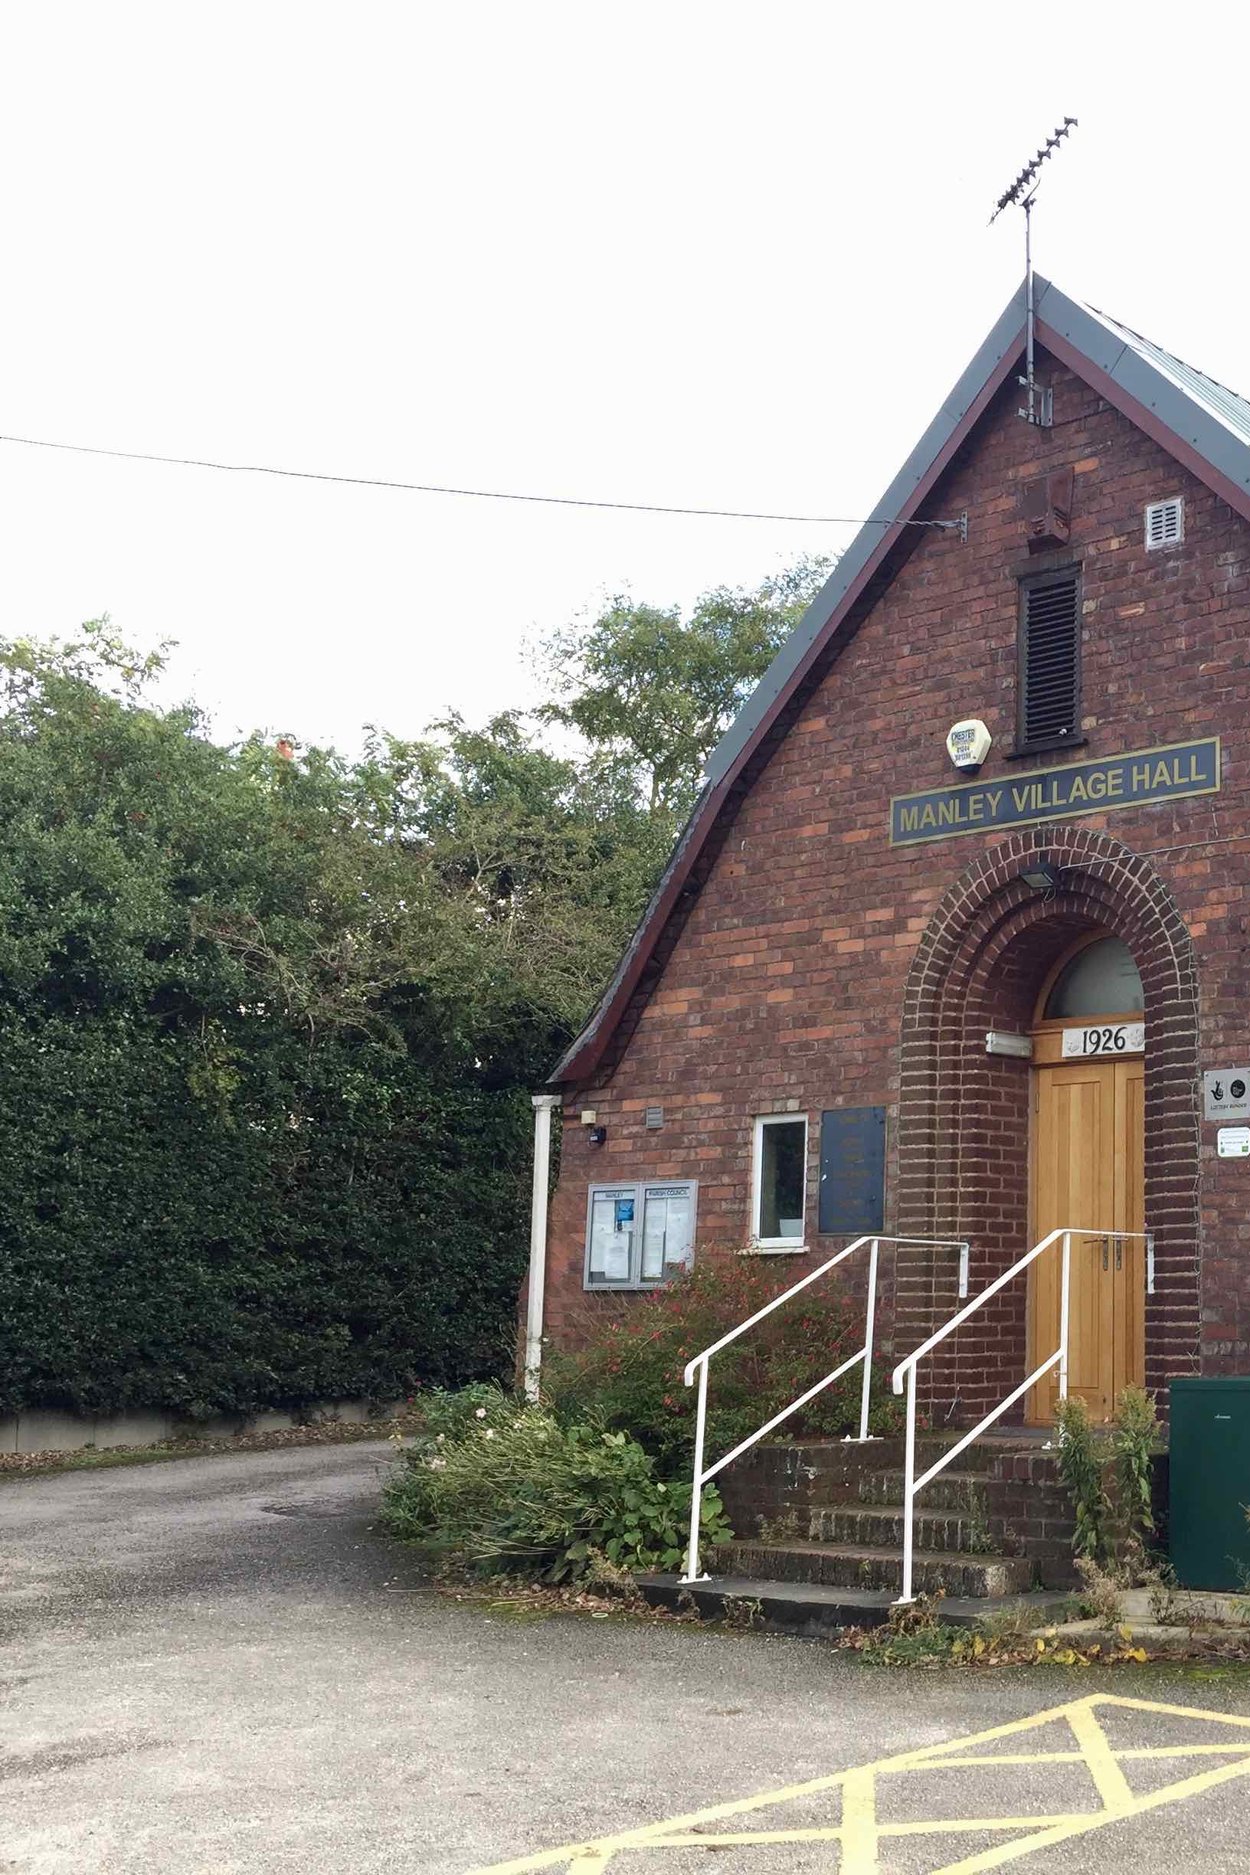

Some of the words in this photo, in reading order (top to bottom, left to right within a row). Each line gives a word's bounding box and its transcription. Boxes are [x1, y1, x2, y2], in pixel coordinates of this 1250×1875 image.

[900, 790, 1003, 833] MANLEY
[1012, 768, 1124, 813] VILLAGE
[1132, 754, 1207, 792] HALL
[1082, 1026, 1128, 1055] 1926
[666, 1188, 688, 1196] COUNCIL
